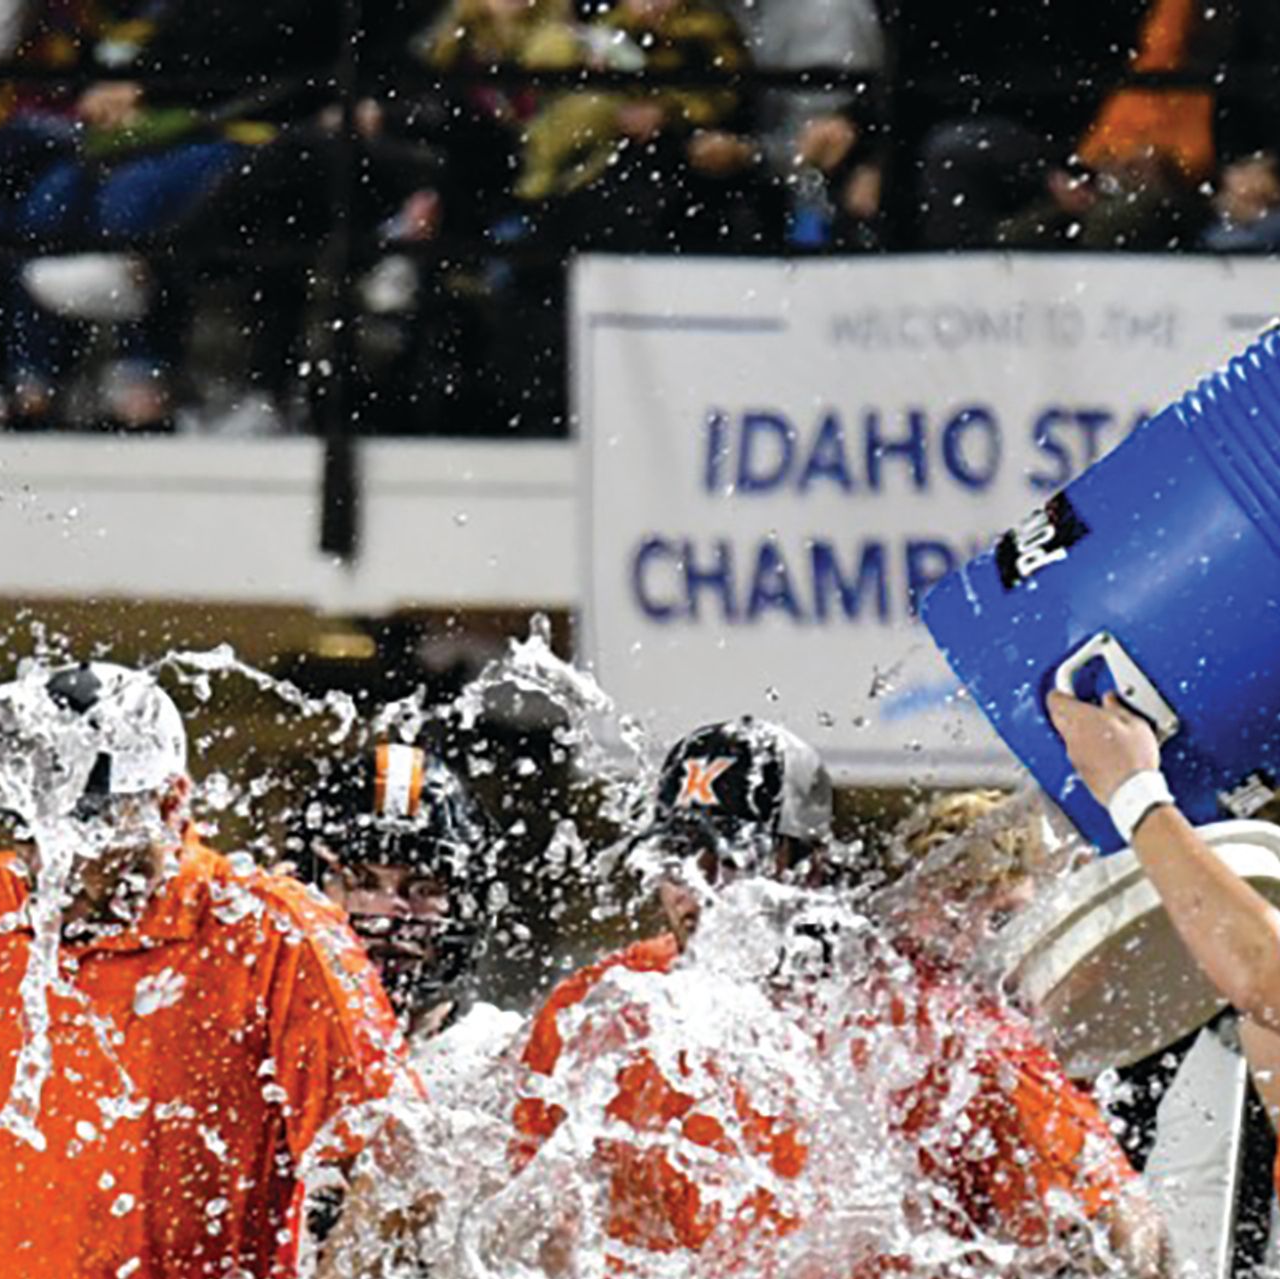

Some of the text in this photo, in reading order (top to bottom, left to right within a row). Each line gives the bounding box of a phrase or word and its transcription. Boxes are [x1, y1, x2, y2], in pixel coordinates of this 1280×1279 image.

[704, 406, 1152, 494] IDAHO ST
[629, 536, 960, 621] CHAMP
[676, 755, 738, 808] K
